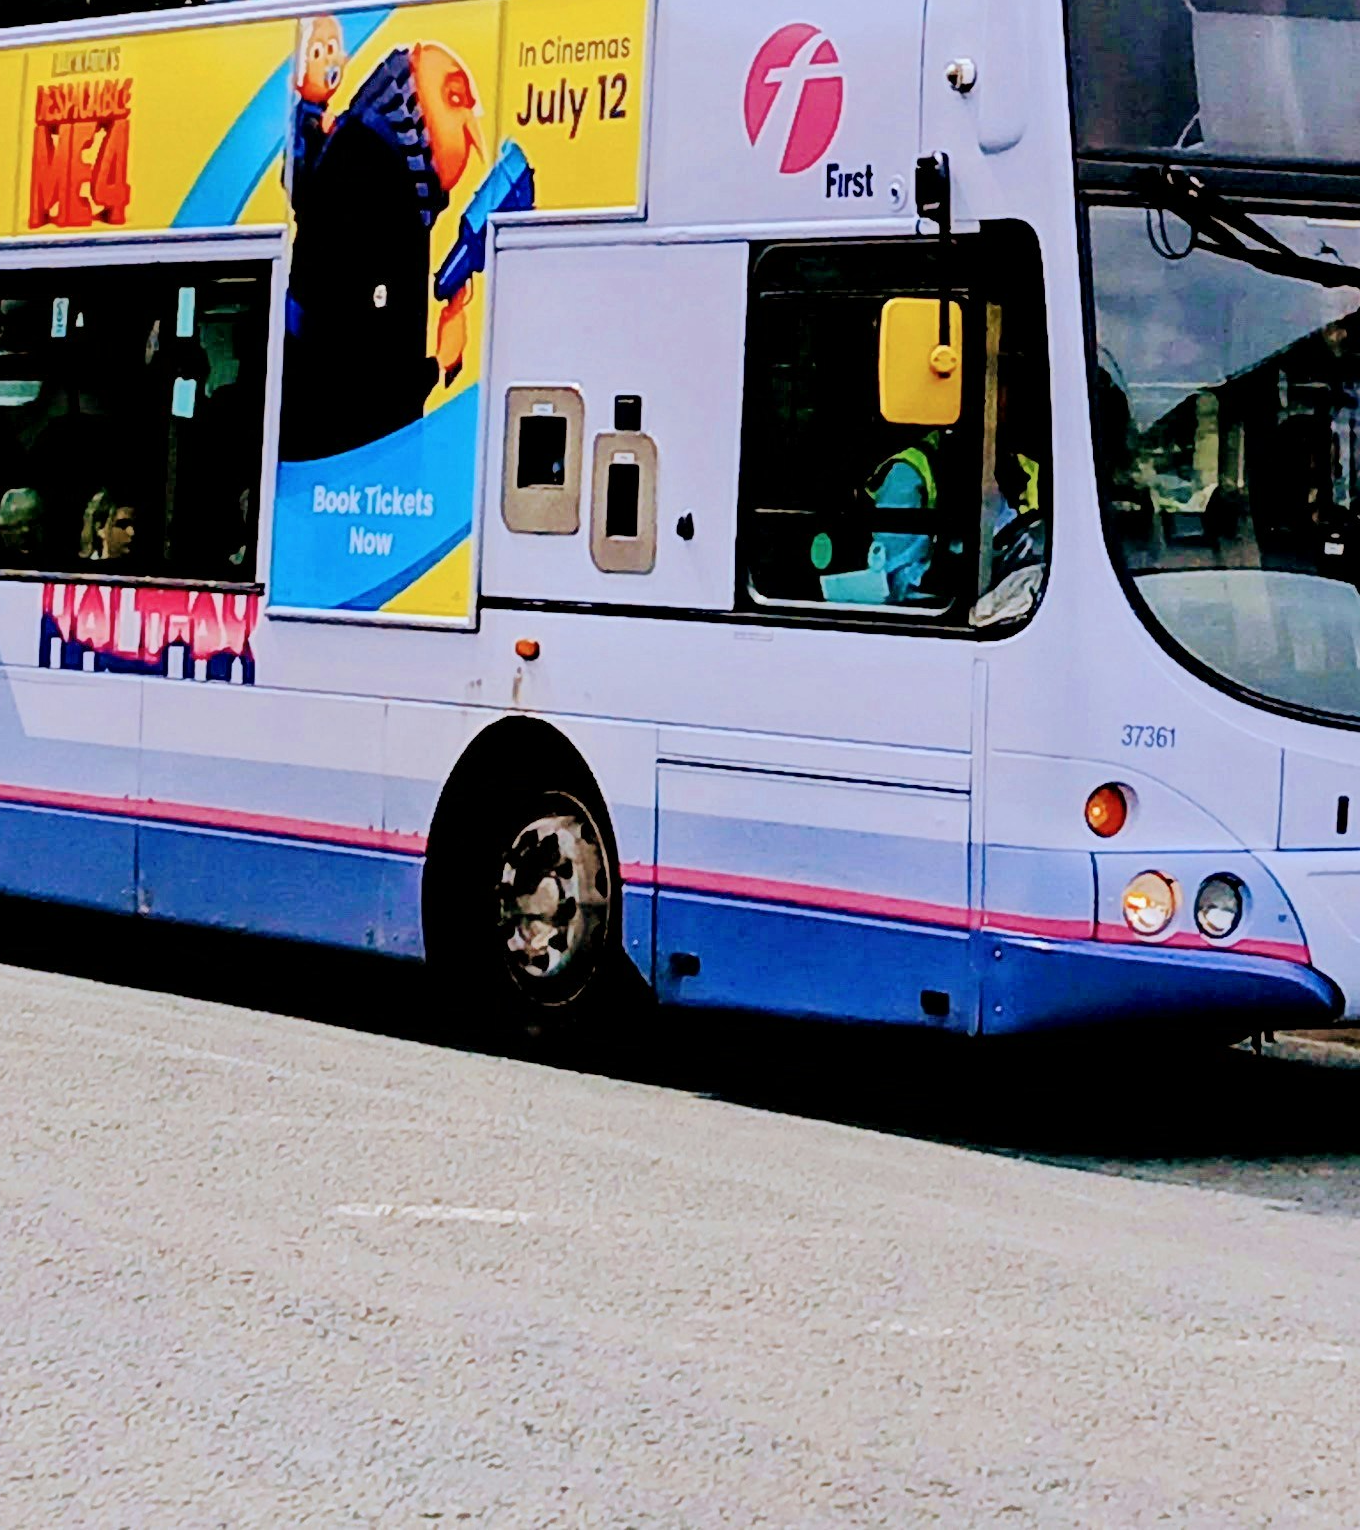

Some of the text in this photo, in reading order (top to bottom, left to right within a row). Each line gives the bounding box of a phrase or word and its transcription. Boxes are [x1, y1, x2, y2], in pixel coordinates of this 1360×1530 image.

[519, 35, 630, 67] In Cinemas
[517, 73, 627, 139] July 12
[28, 120, 131, 230] ME 4
[826, 163, 873, 198] First
[313, 484, 434, 517] Book Tickets
[349, 526, 393, 556] Now
[1121, 724, 1175, 748] 37361
